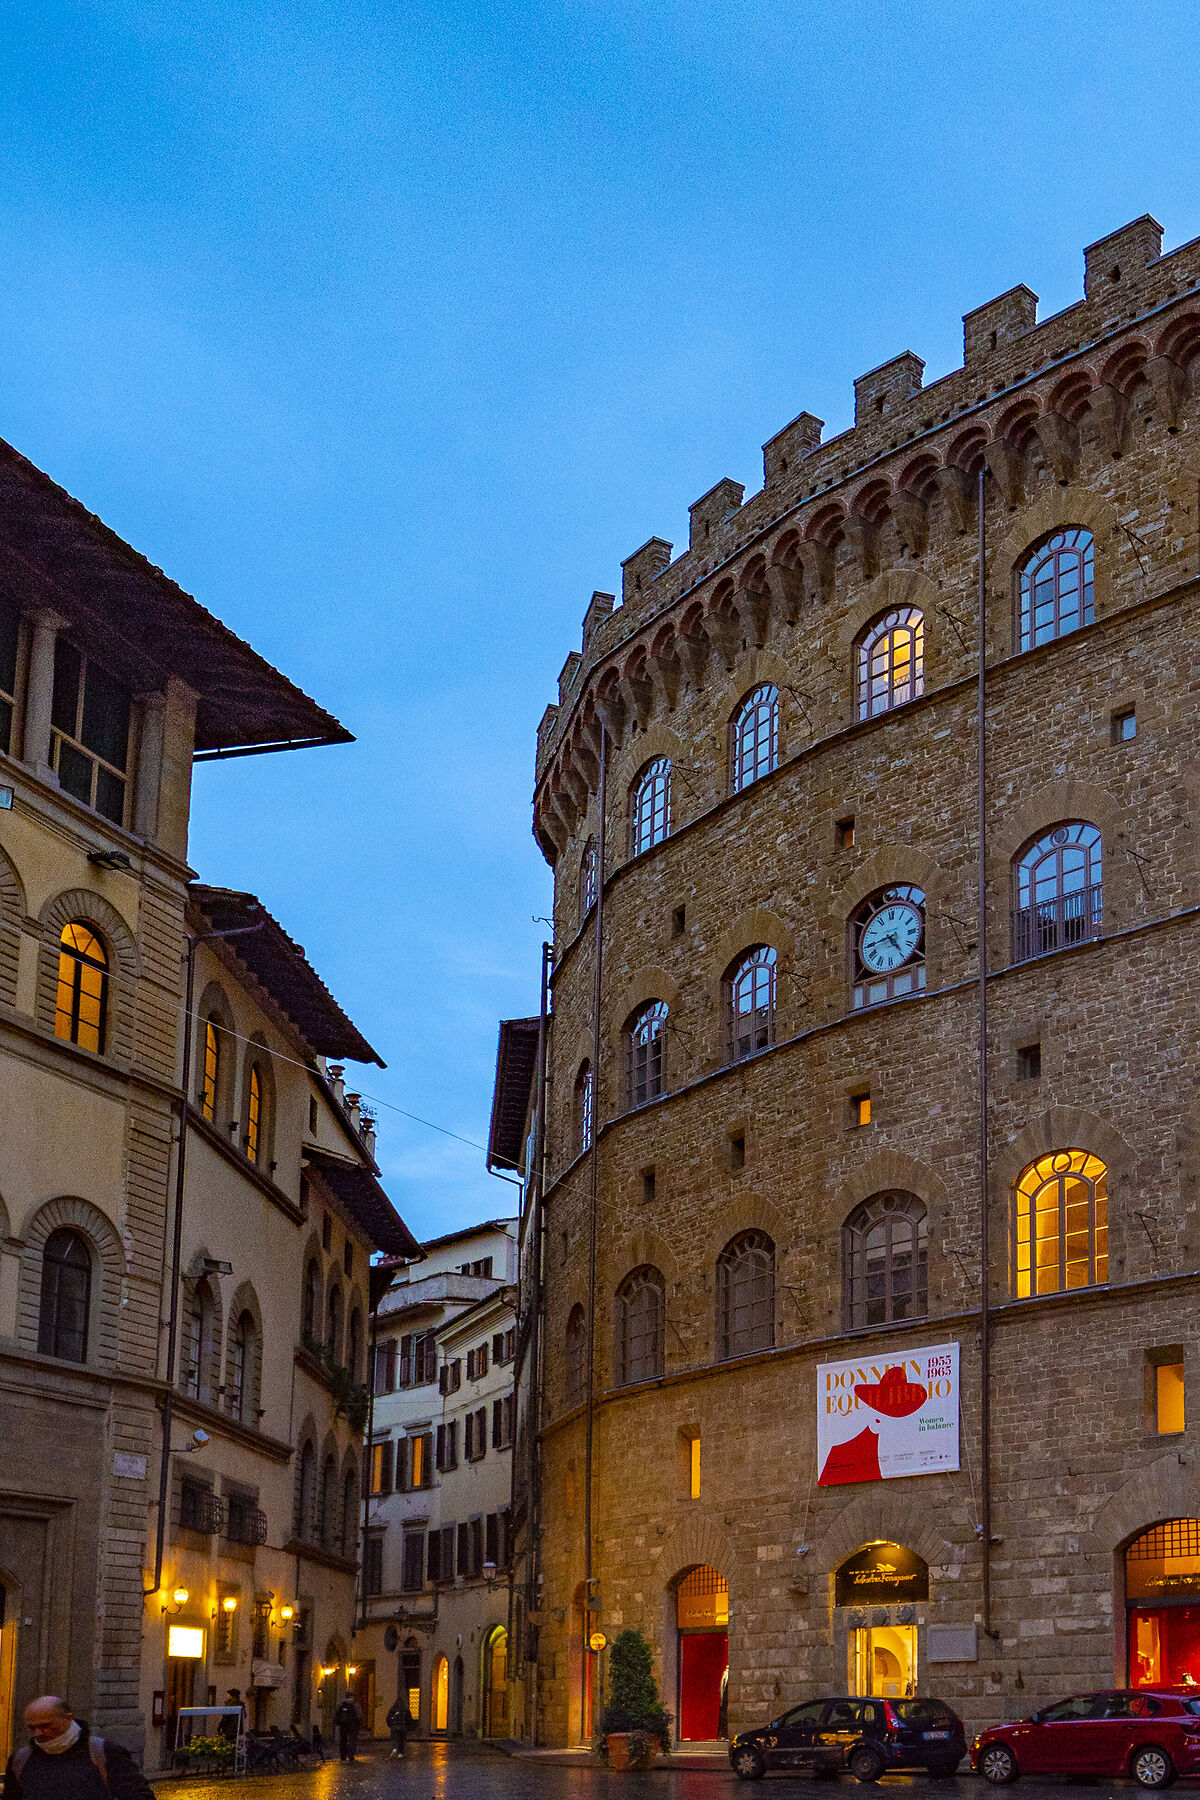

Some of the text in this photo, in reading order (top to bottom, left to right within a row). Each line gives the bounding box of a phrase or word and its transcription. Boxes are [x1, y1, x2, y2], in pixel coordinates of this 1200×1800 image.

[927, 1355, 952, 1368] 1955
[926, 1366, 952, 1379] 1965
[927, 1422, 954, 1430] balance
